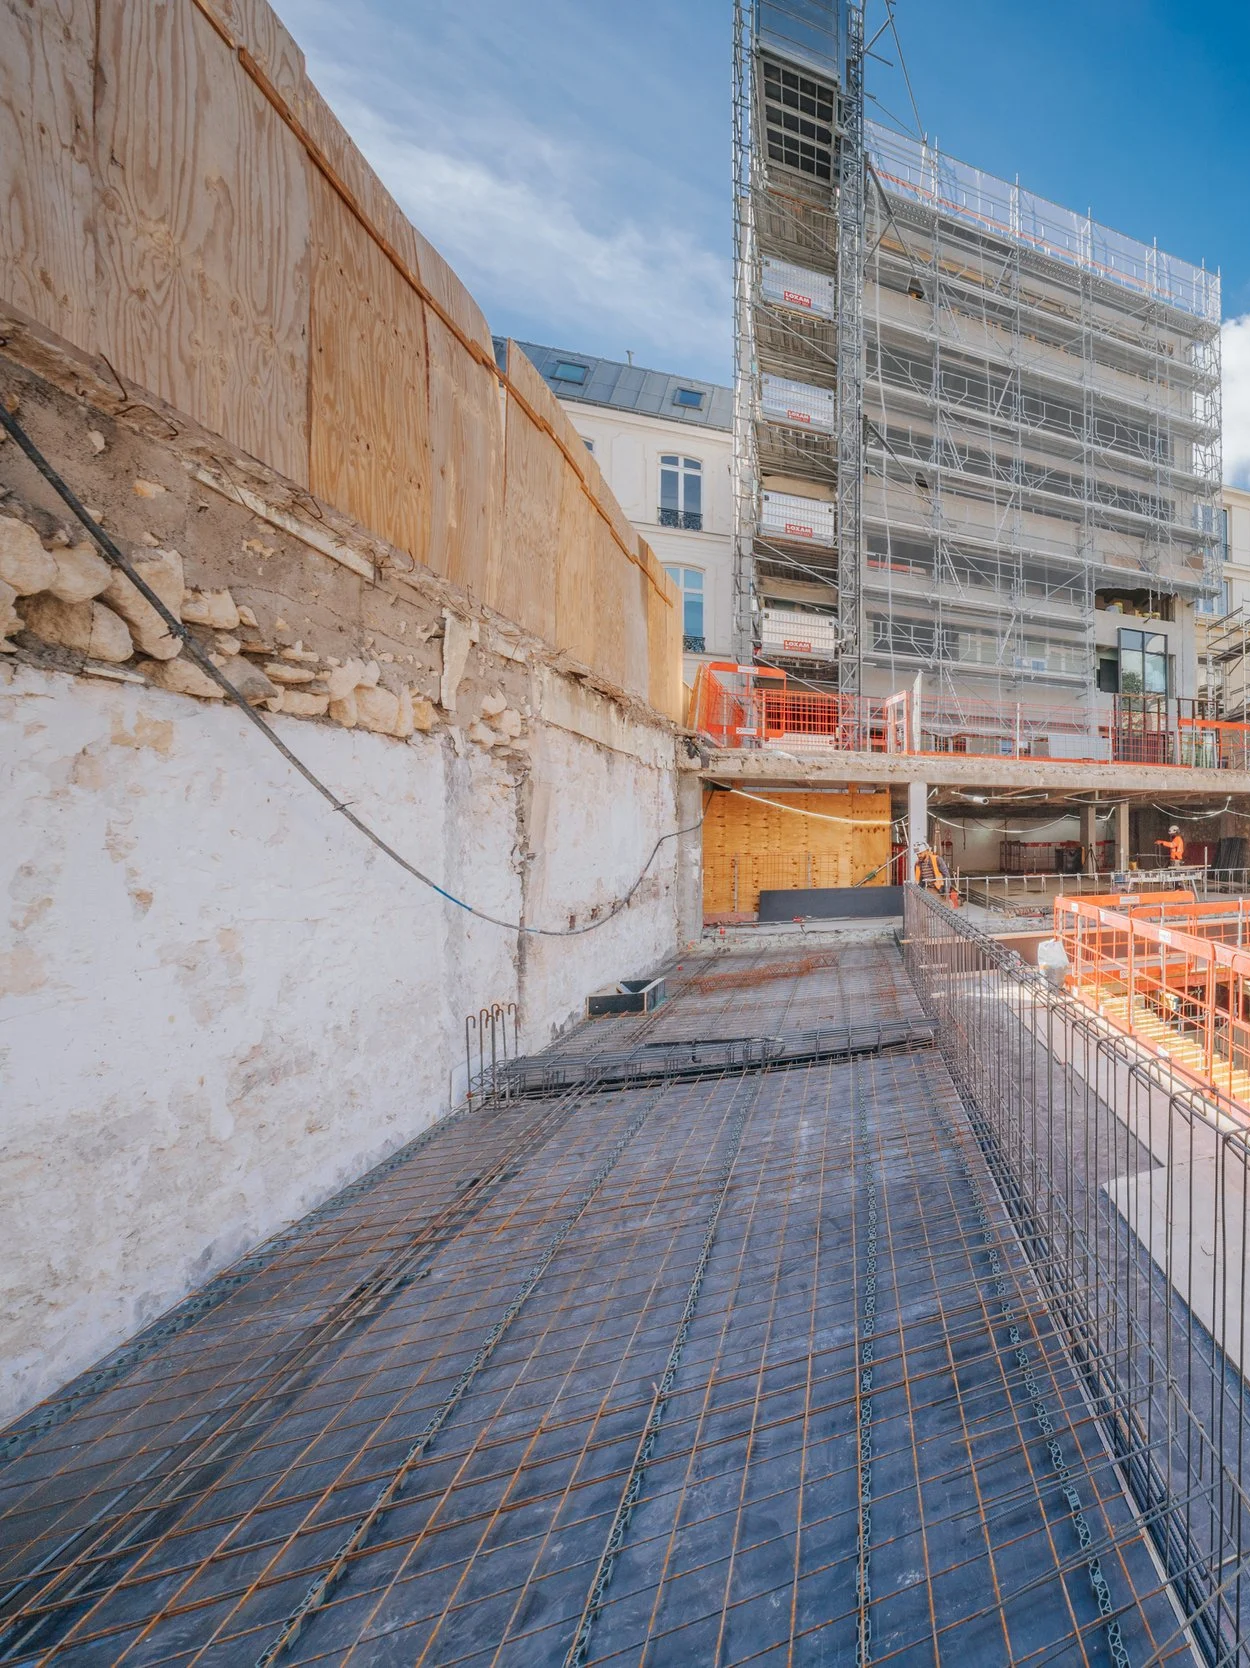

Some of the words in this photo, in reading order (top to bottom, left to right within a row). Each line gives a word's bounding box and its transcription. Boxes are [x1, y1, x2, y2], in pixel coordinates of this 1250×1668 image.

[785, 292, 810, 304] LOXAM
[786, 524, 811, 533] LOXAM
[785, 641, 810, 649] LOXAM
